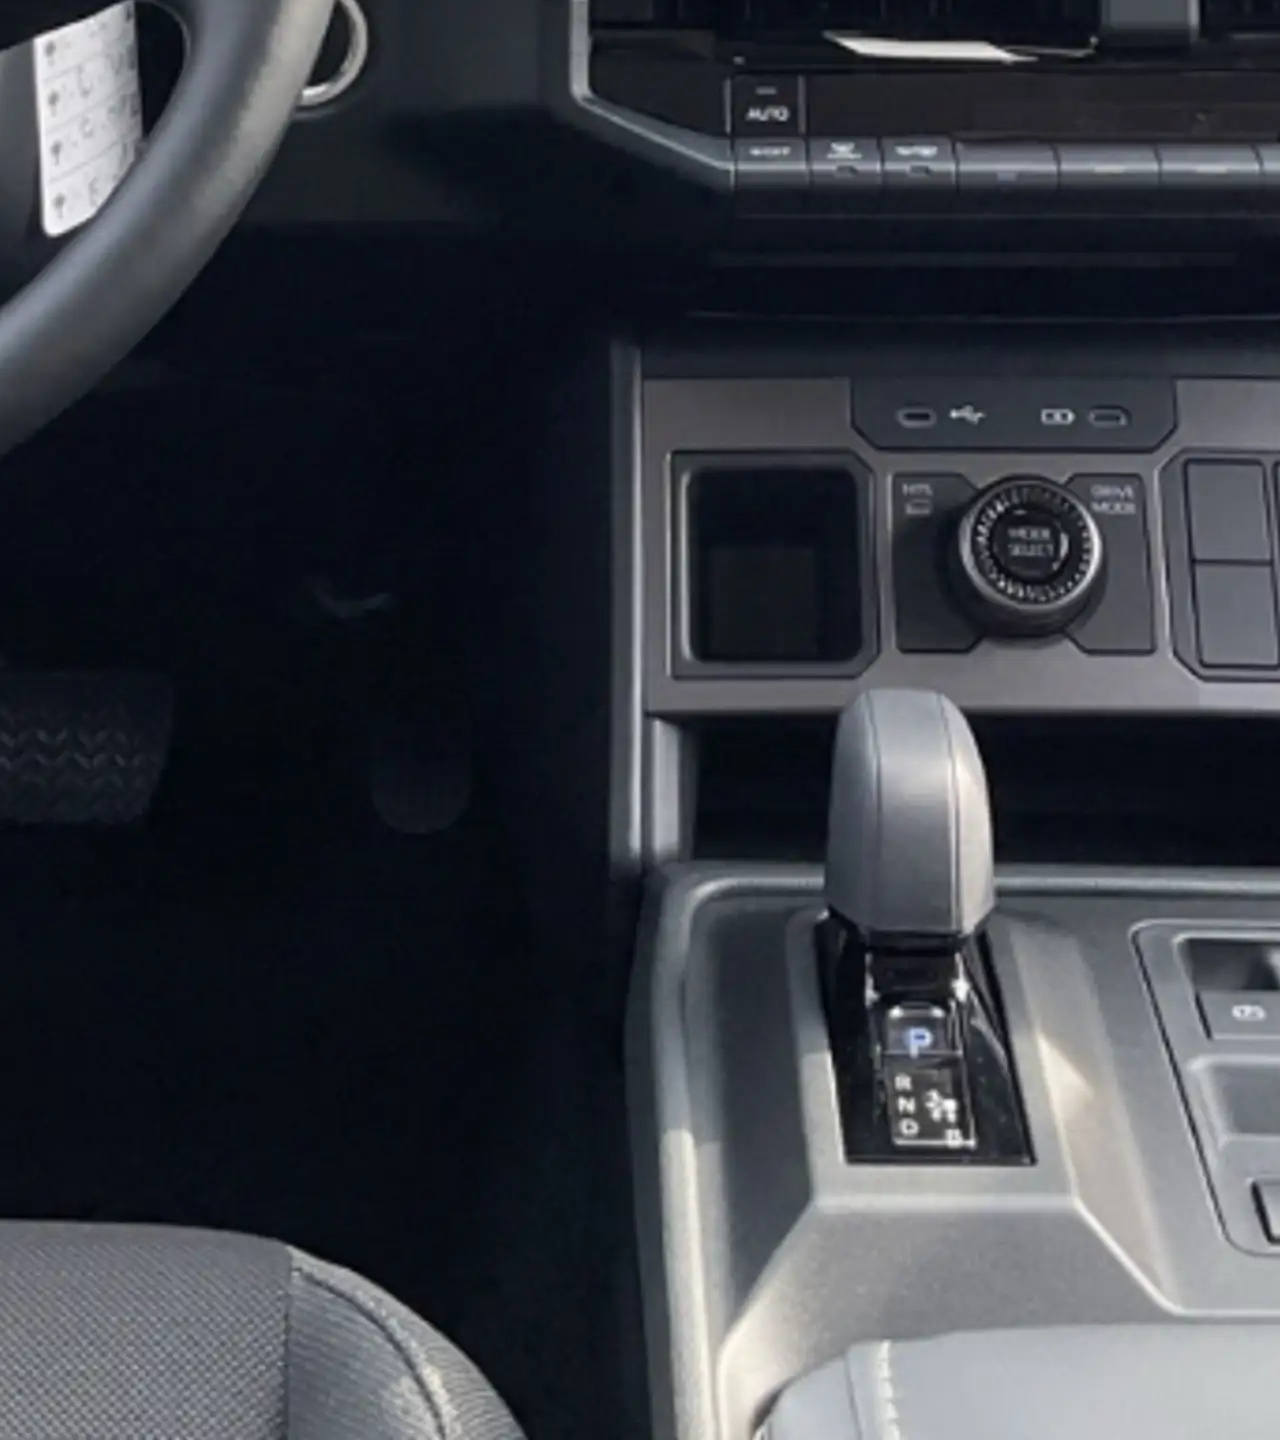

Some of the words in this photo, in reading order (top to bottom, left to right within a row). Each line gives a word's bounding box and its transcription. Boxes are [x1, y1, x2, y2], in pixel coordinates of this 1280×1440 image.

[746, 105, 789, 121] AUTO
[907, 1027, 934, 1058] P
[894, 1072, 912, 1091] R
[897, 1096, 916, 1114] N
